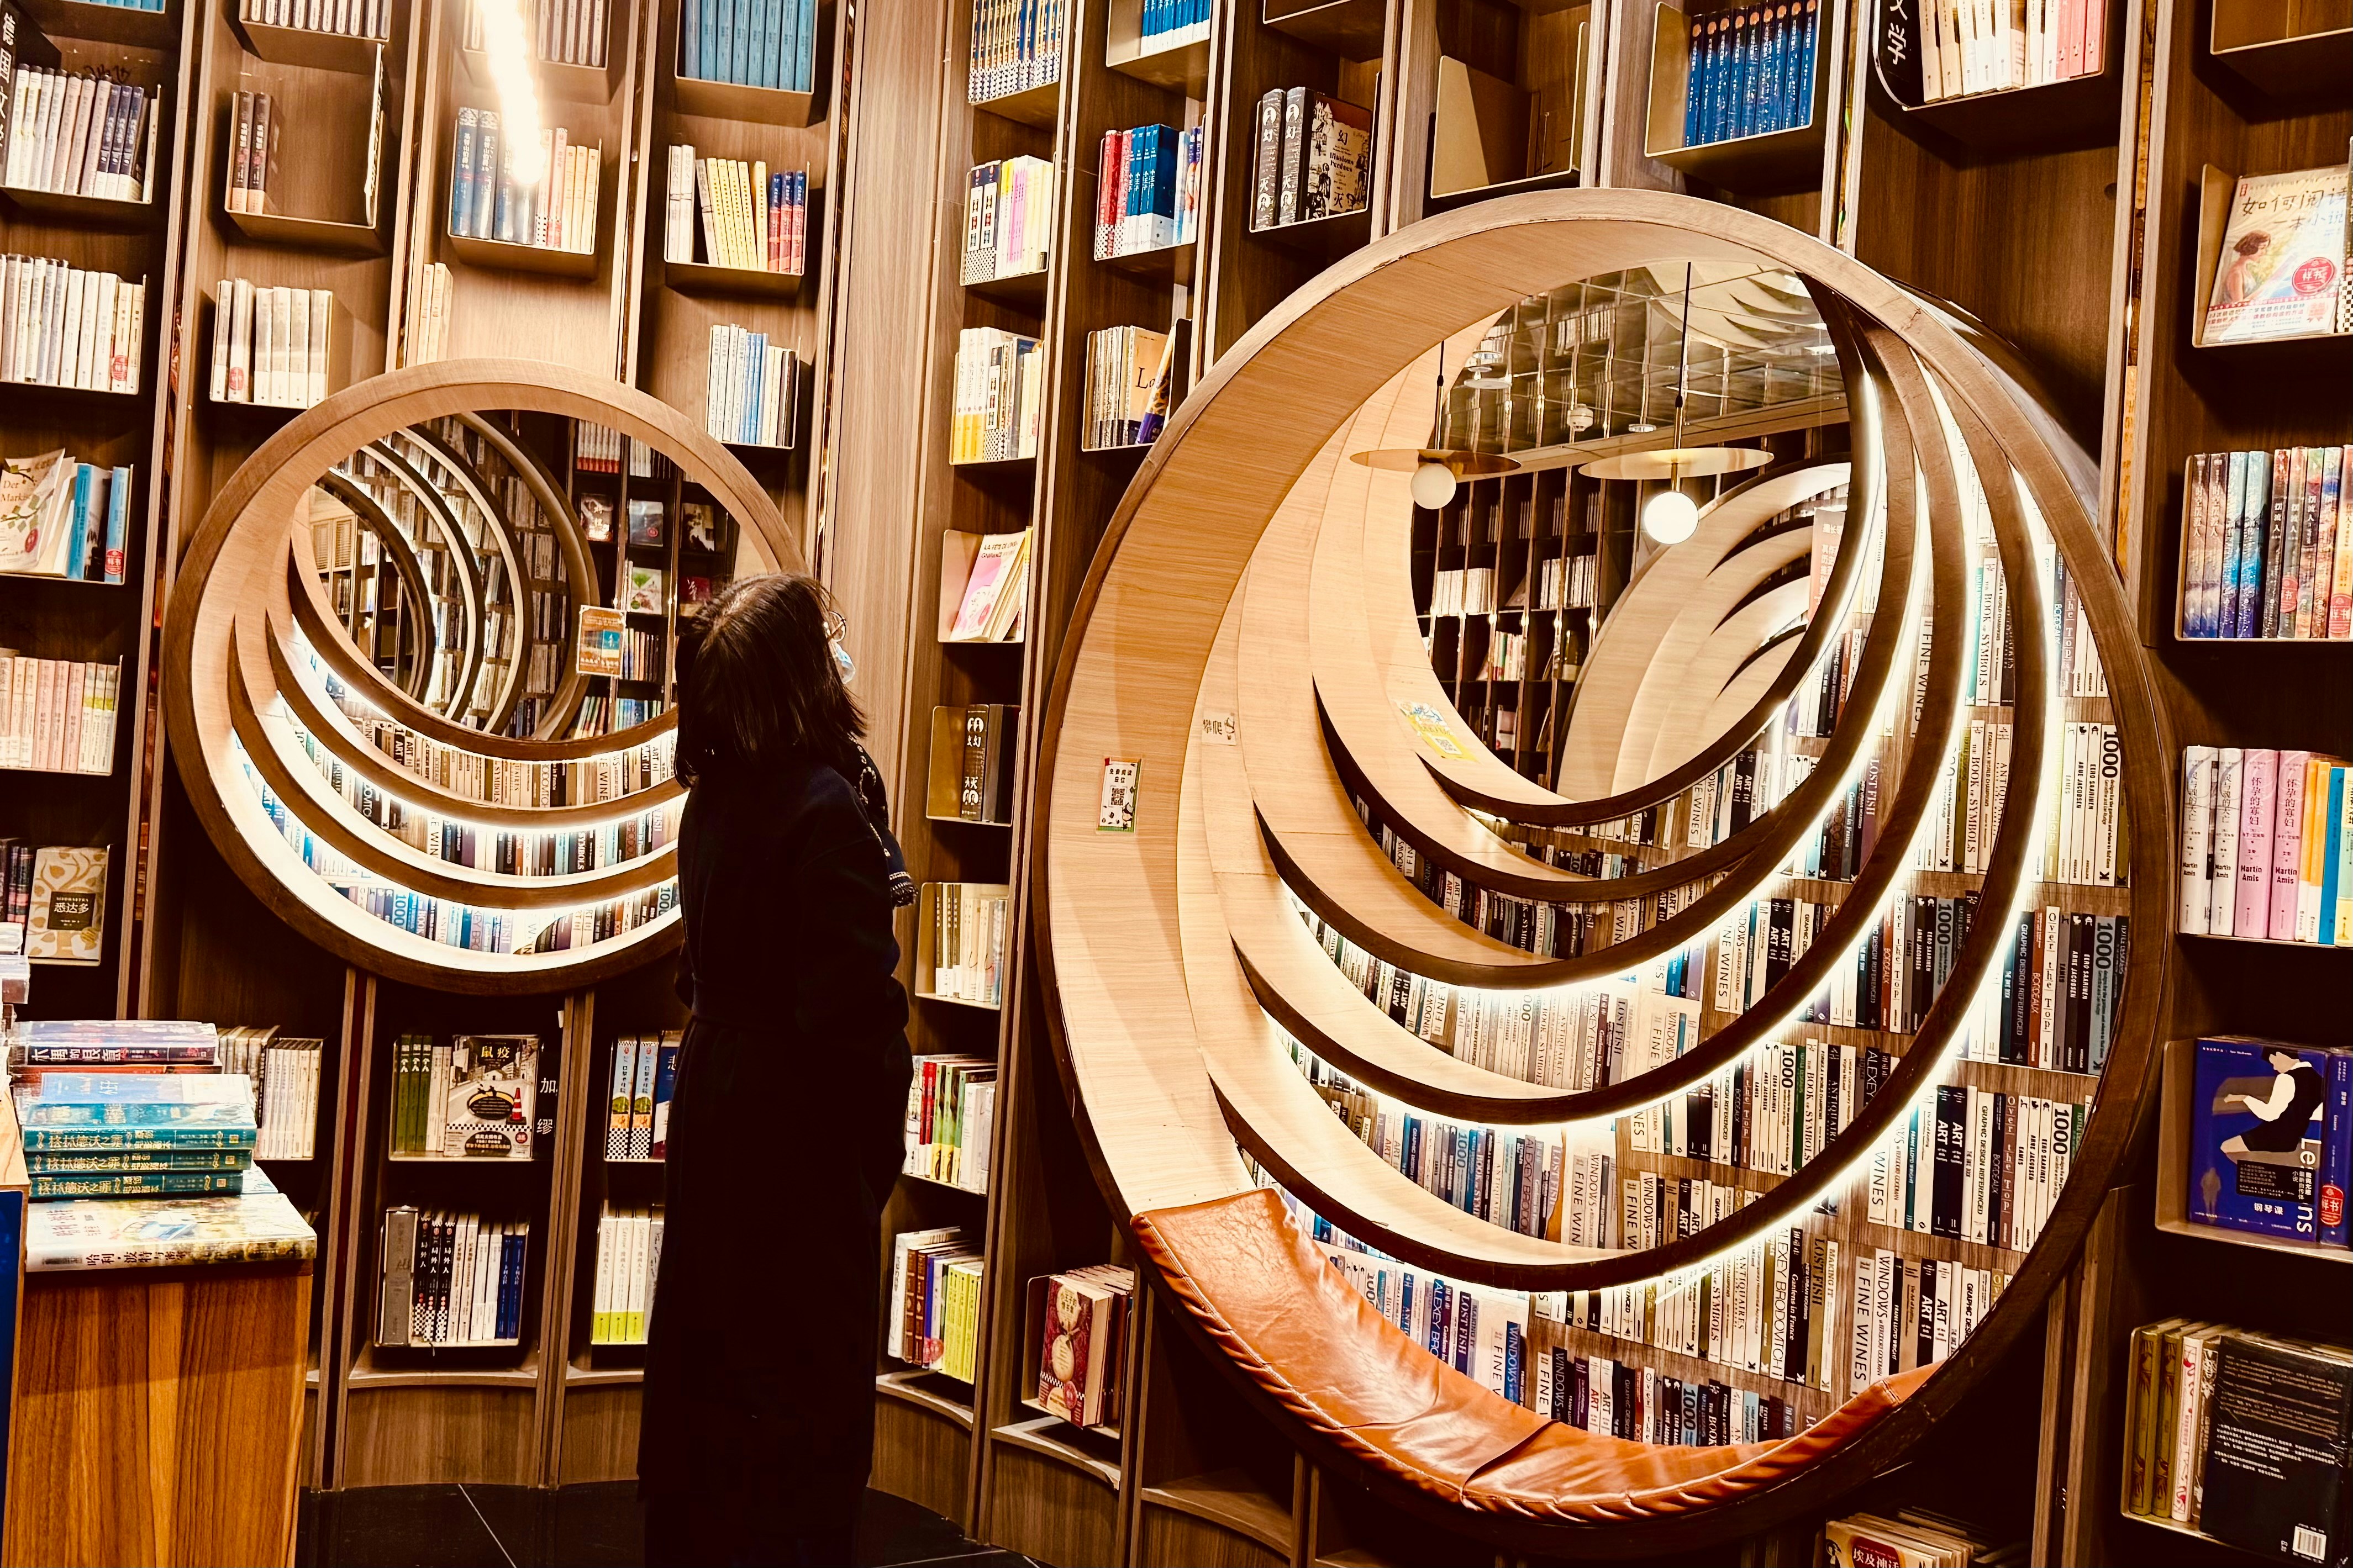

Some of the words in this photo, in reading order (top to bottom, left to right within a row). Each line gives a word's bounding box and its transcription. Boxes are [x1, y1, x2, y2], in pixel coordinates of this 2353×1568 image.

[1262, 129, 1273, 142] 幻
[1285, 125, 1297, 140] 幻
[1337, 129, 1349, 146] 幻
[1259, 176, 1271, 193] 灭
[1282, 173, 1295, 190] 灭
[1333, 192, 1344, 209] 灭
[2241, 186, 2348, 217] 如何阅读
[2273, 209, 2344, 230] 一本小说
[1983, 593, 1993, 622] BOOK
[1919, 633, 1933, 667] FINE
[1978, 634, 1990, 686] SYMBOLS
[2102, 731, 2119, 778] 1000
[1735, 773, 1743, 791] ART
[1744, 774, 1752, 792] ART
[1868, 758, 1880, 790] LOST
[1970, 757, 1981, 788] BOOK
[1691, 798, 1702, 836] WINES
[1846, 790, 1856, 817] Gardens
[1865, 790, 1877, 816] FISH
[2249, 777, 2262, 826] 怀孕的寡妇
[2283, 778, 2298, 828] 怀孕的寡妇
[1844, 826, 1852, 848] France
[1967, 799, 1978, 853] SYMBOLS
[2240, 864, 2263, 874] Martin
[2241, 873, 2260, 883] Amis
[2275, 866, 2298, 875] Martin
[2276, 875, 2295, 885] Amis
[394, 893, 408, 927] 1000
[1936, 903, 1952, 945] 1000
[1770, 926, 1780, 947] ART
[1781, 927, 1791, 948] ART
[2019, 923, 2029, 958] GRAPHIC
[2047, 911, 2056, 950] Over
[2095, 922, 2114, 969] 1000
[2018, 959, 2027, 986] DESIGN
[2070, 950, 2078, 967] ARNE
[2082, 953, 2091, 970] EERO
[1718, 953, 1730, 997] WINES
[2069, 968, 2078, 999] JACOBSEN
[1615, 1000, 1626, 1027] LOST
[2016, 988, 2025, 1036] REFERENCED
[2043, 997, 2052, 1031] Top
[1613, 1029, 1624, 1055] FISH
[1650, 1028, 1662, 1059] FINE
[1665, 1011, 1677, 1060] WINDOWS
[480, 1045, 510, 1059] 鼠疫
[1781, 1049, 1794, 1089] 1000
[1866, 1049, 1878, 1099] ALEXEY
[1805, 1072, 1815, 1100] BOOK
[1980, 1105, 1988, 1138] GRAPHIC
[2007, 1096, 2015, 1132] Over
[1804, 1110, 1813, 1162] SYMBOLS
[1937, 1119, 1949, 1145] ART
[1951, 1121, 1964, 1148] ART
[2052, 1108, 2070, 1155] 1000
[1383, 1137, 1392, 1158] ART
[1456, 1132, 1468, 1168] 1000
[1573, 1171, 1585, 1205] FINE
[1588, 1153, 1600, 1207] WINDOWS
[1871, 1151, 1886, 1206] WINES
[1977, 1167, 1986, 1215] REFERENCED
[2296, 1137, 2322, 1233] Lens
[1643, 1176, 1654, 1230] WINDOWS
[2003, 1179, 2012, 1211] Top
[2253, 1202, 2284, 1216] 钢琴课
[1626, 1195, 1638, 1229] FINE
[1679, 1208, 1689, 1233] ART
[419, 1241, 428, 1268] 局外人
[430, 1247, 439, 1274] 局外人
[442, 1247, 451, 1274] 局外人
[1776, 1227, 1789, 1279] ALEXEY
[1813, 1237, 1826, 1271] LOST
[1789, 1273, 1799, 1305] Gardens
[1812, 1275, 1823, 1306] FISH
[1856, 1276, 1871, 1317] FINE
[1876, 1255, 1891, 1319] WINDOWS
[1965, 1282, 1974, 1317] GRAPHIC
[1431, 1281, 1444, 1329] ALEXEY
[1460, 1294, 1470, 1324] LOST
[1710, 1286, 1720, 1342] SYMBOLS
[1920, 1294, 1933, 1322] ART
[1936, 1298, 1948, 1326] ART
[1771, 1280, 1787, 1370] BRODOVITCH
[1788, 1315, 1797, 1341] France
[1458, 1327, 1468, 1355] FISH
[1507, 1326, 1519, 1383] WINDOWS
[1854, 1324, 1869, 1381] WINES
[1492, 1345, 1503, 1381] FINE
[1539, 1369, 1550, 1406] FINE
[1554, 1352, 1565, 1408] WINDOWS
[1590, 1388, 1599, 1412] ART
[1602, 1391, 1611, 1415] ART
[1683, 1388, 1697, 1431] 1000
[1708, 1415, 1717, 1446] BOOK
